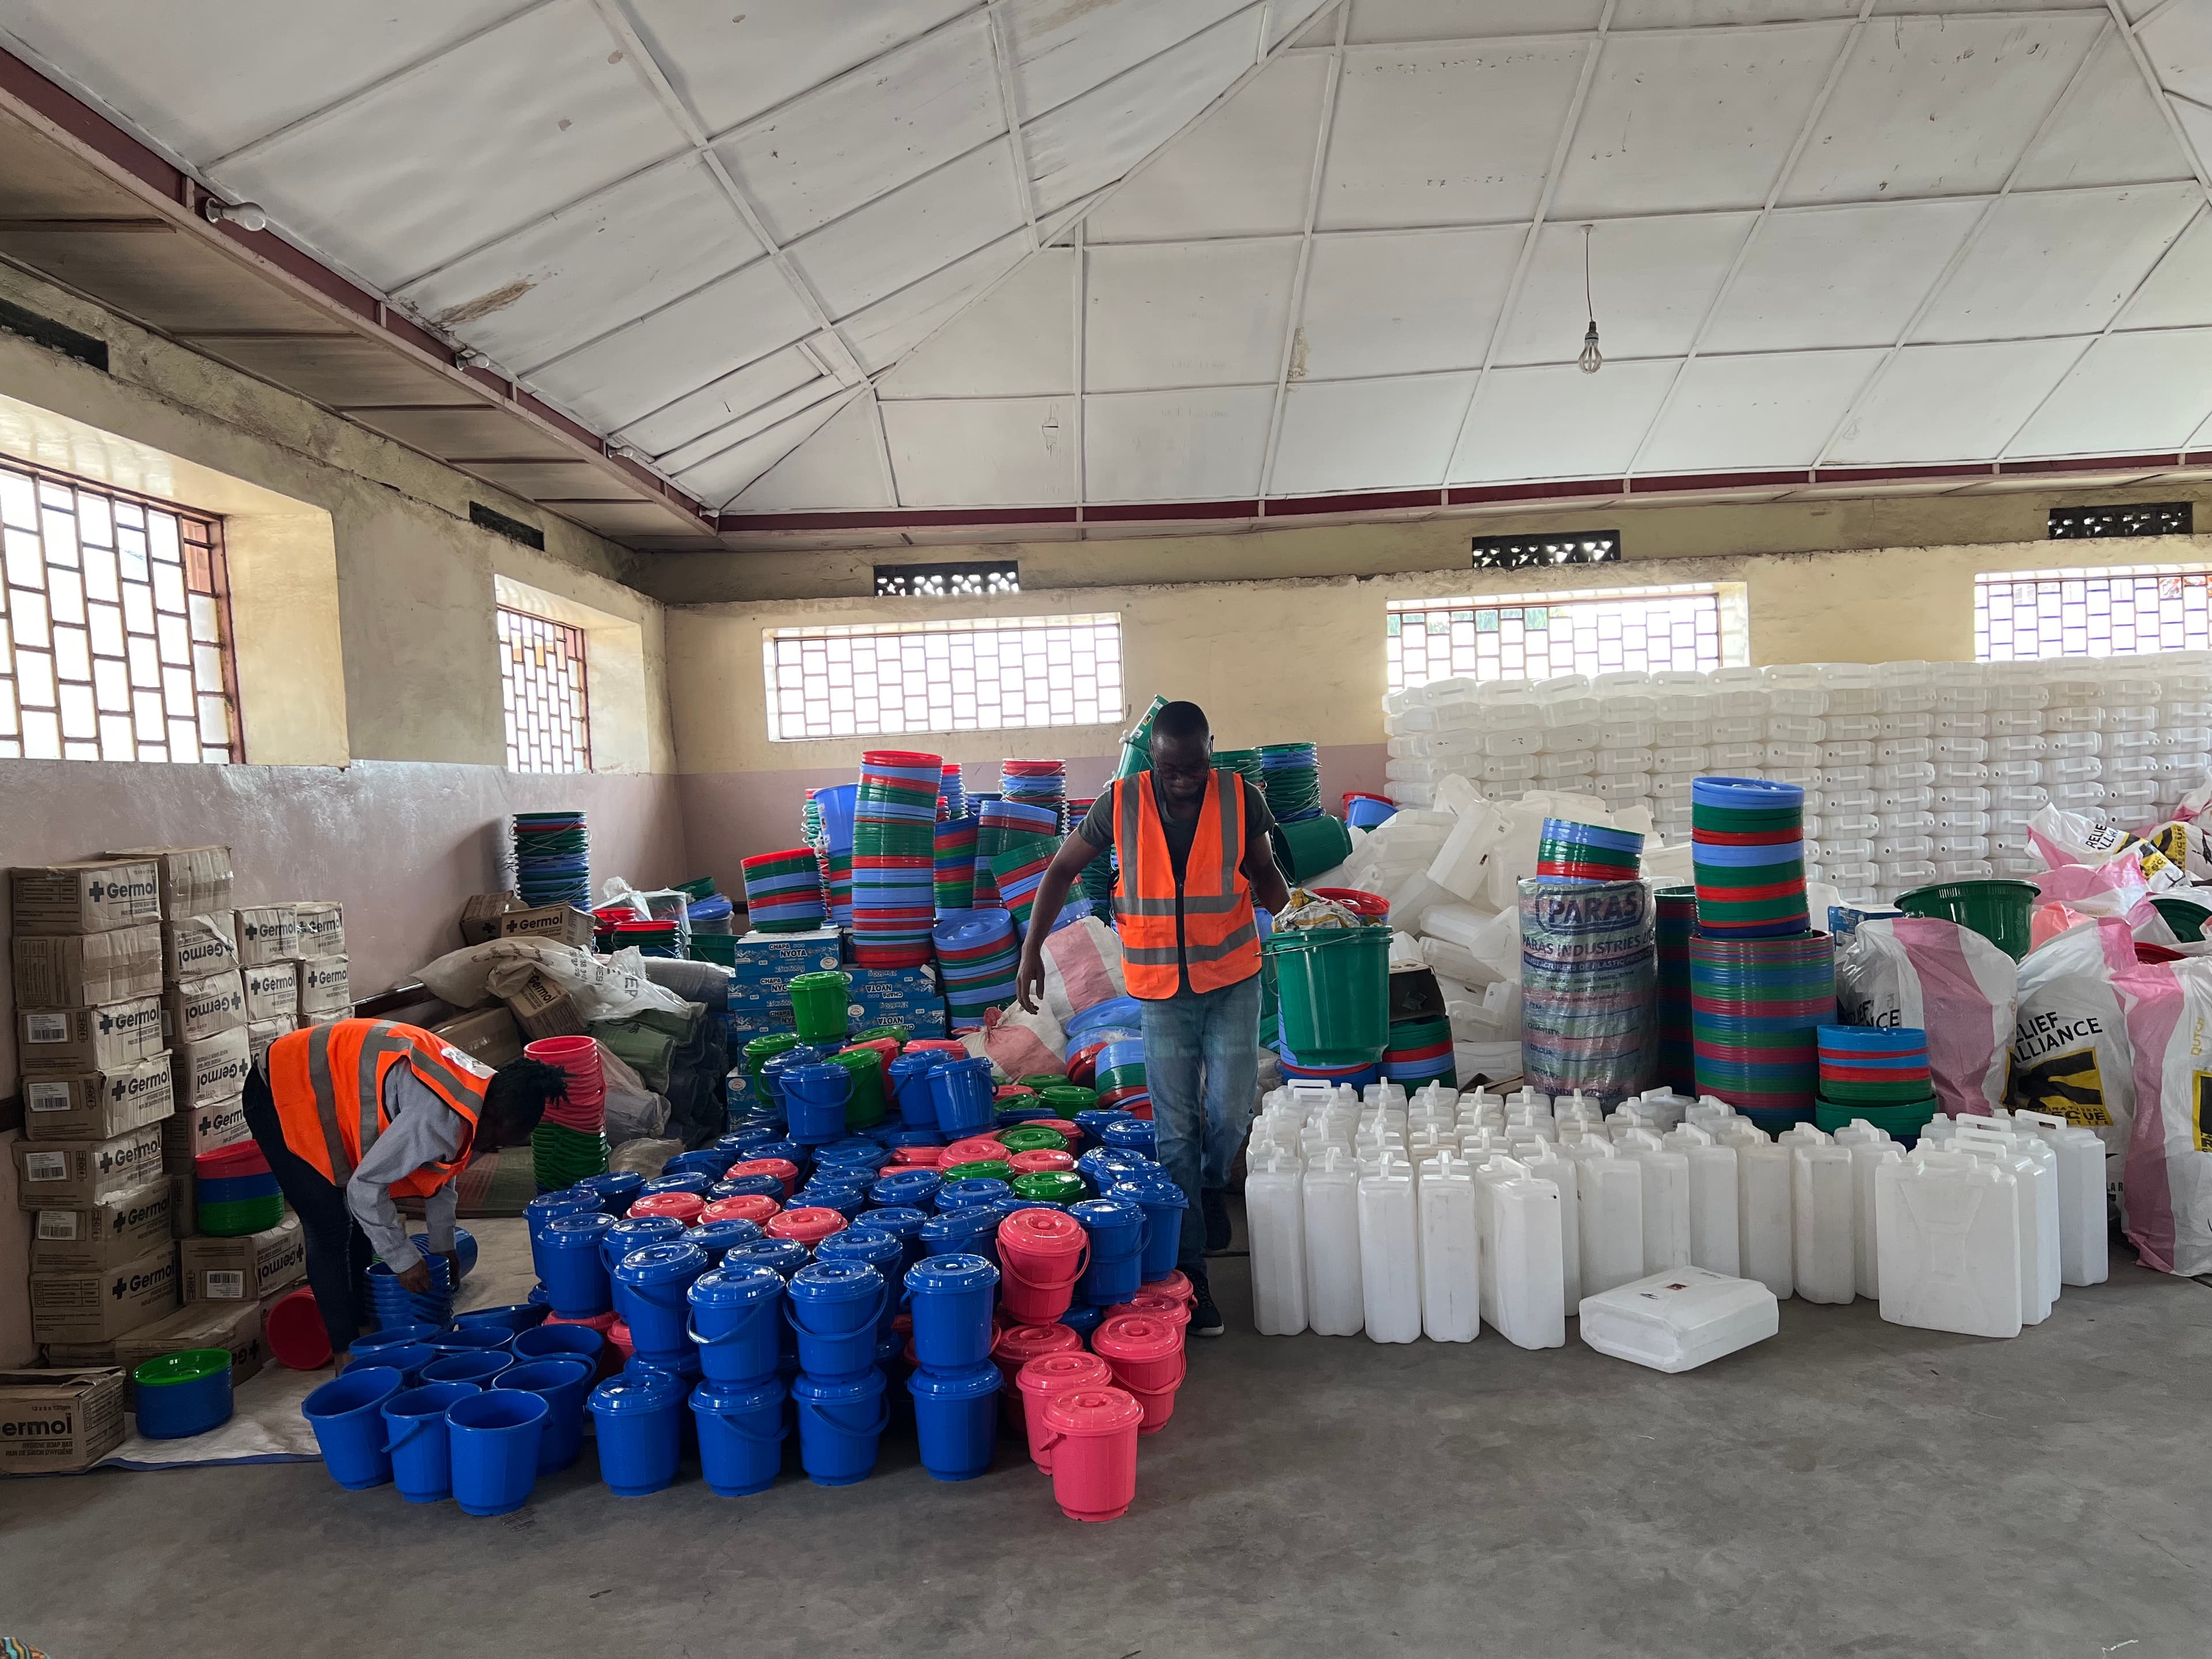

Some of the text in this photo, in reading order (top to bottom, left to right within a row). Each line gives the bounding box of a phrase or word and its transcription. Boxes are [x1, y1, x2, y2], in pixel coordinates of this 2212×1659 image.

[2085, 824, 2107, 849] RELIE
[2097, 828, 2119, 850] ALLIA
[107, 880, 157, 899] Germol
[1548, 891, 1637, 923] PARAS
[260, 921, 296, 937] Germol
[520, 913, 563, 930] Germol
[178, 942, 223, 967] Germol
[780, 950, 806, 958] NYOTA
[1522, 934, 1554, 955] PARAS
[1557, 935, 1641, 957] INDUSTRIES
[263, 974, 296, 991] Germol
[529, 976, 558, 1003] Germol
[760, 977, 782, 985] CHAPA
[771, 984, 787, 993] NYO
[866, 983, 893, 993] NYOTA
[116, 1005, 159, 1029] Germol
[185, 997, 230, 1023] Germol
[770, 1009, 791, 1017] CHAPA
[878, 1016, 904, 1025] NYOTA
[2016, 1012, 2058, 1043] LIEF
[128, 1066, 170, 1094] Germol
[196, 1063, 237, 1091] Germol
[213, 1109, 242, 1129] Germ
[115, 1134, 161, 1166] Germol
[128, 1195, 170, 1225] Germol
[130, 1259, 175, 1291] Germol
[259, 1253, 296, 1283] Germol
[0, 1416, 72, 1436] ermol
